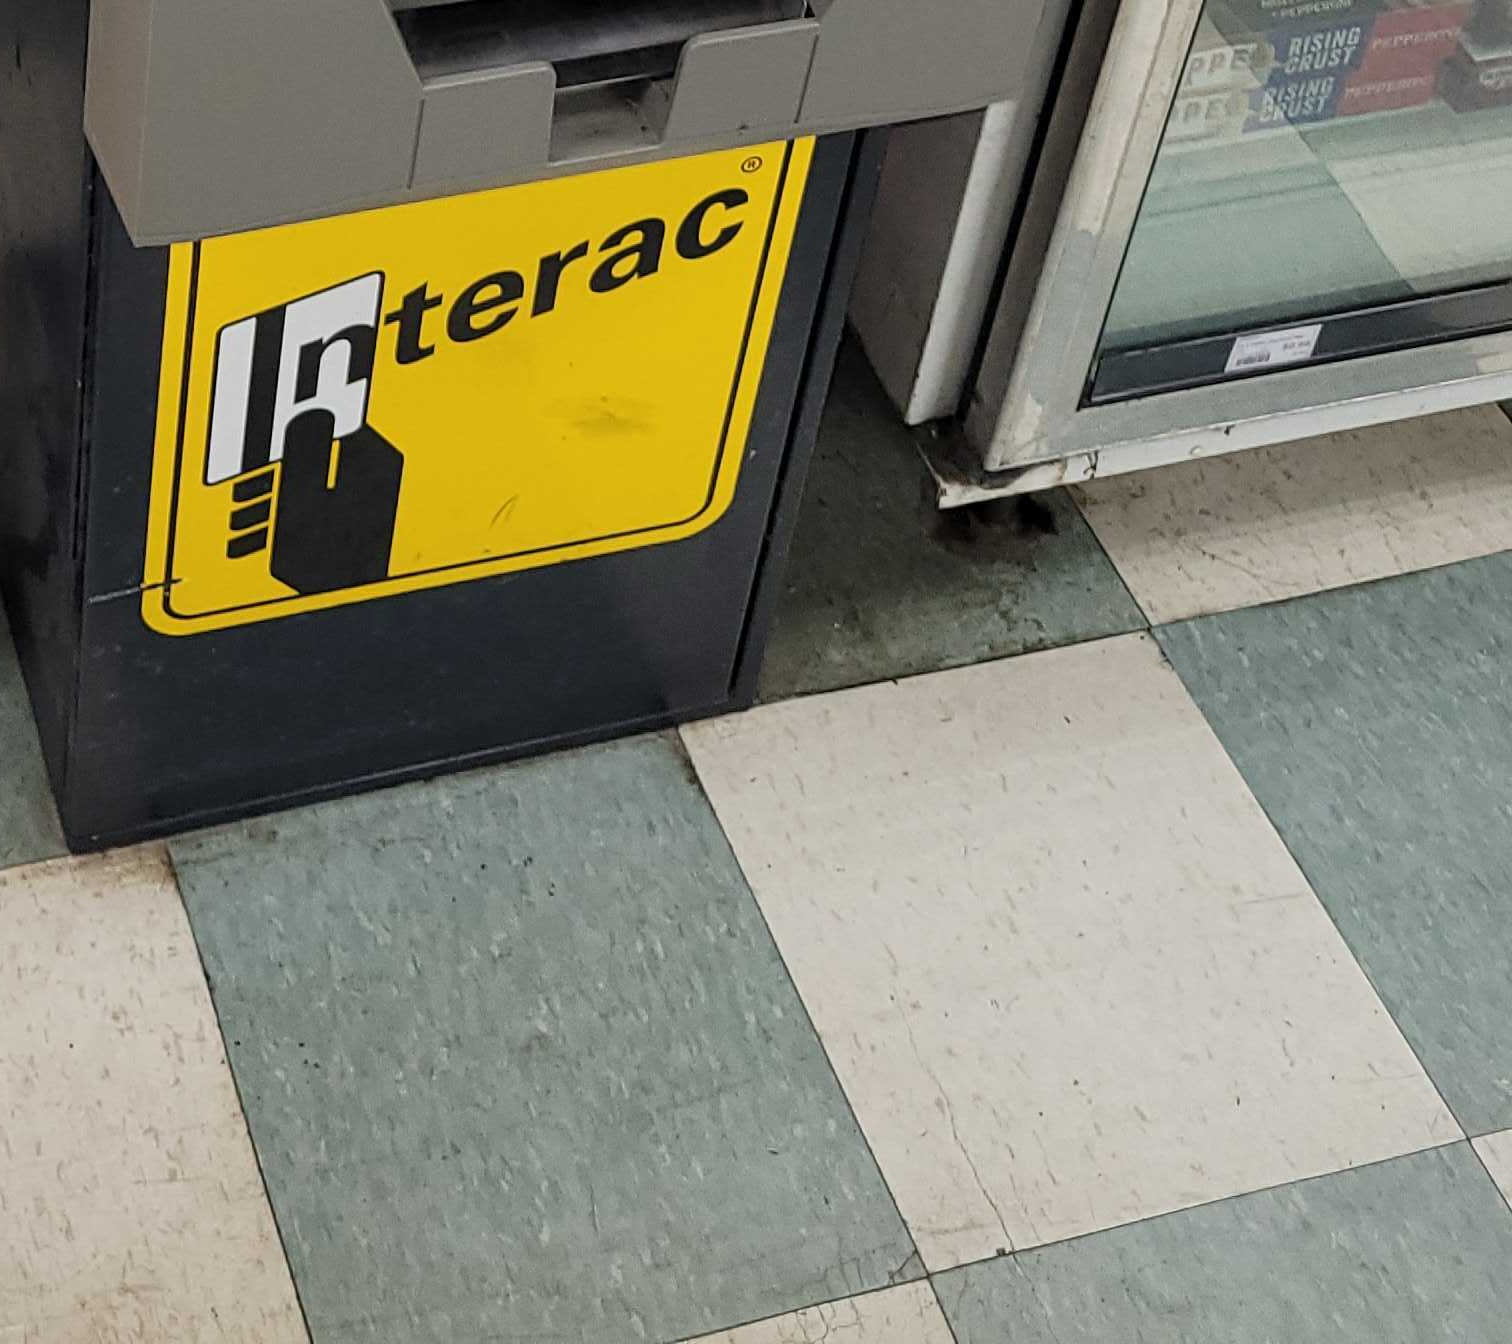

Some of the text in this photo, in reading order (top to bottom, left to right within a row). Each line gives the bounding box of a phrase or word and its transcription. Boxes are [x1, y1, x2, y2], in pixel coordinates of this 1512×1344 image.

[1288, 26, 1362, 58] RISING
[1284, 45, 1357, 74] CRUST
[1262, 75, 1336, 104] RISING
[1258, 94, 1330, 123] CRUST
[240, 187, 750, 475] Interac
